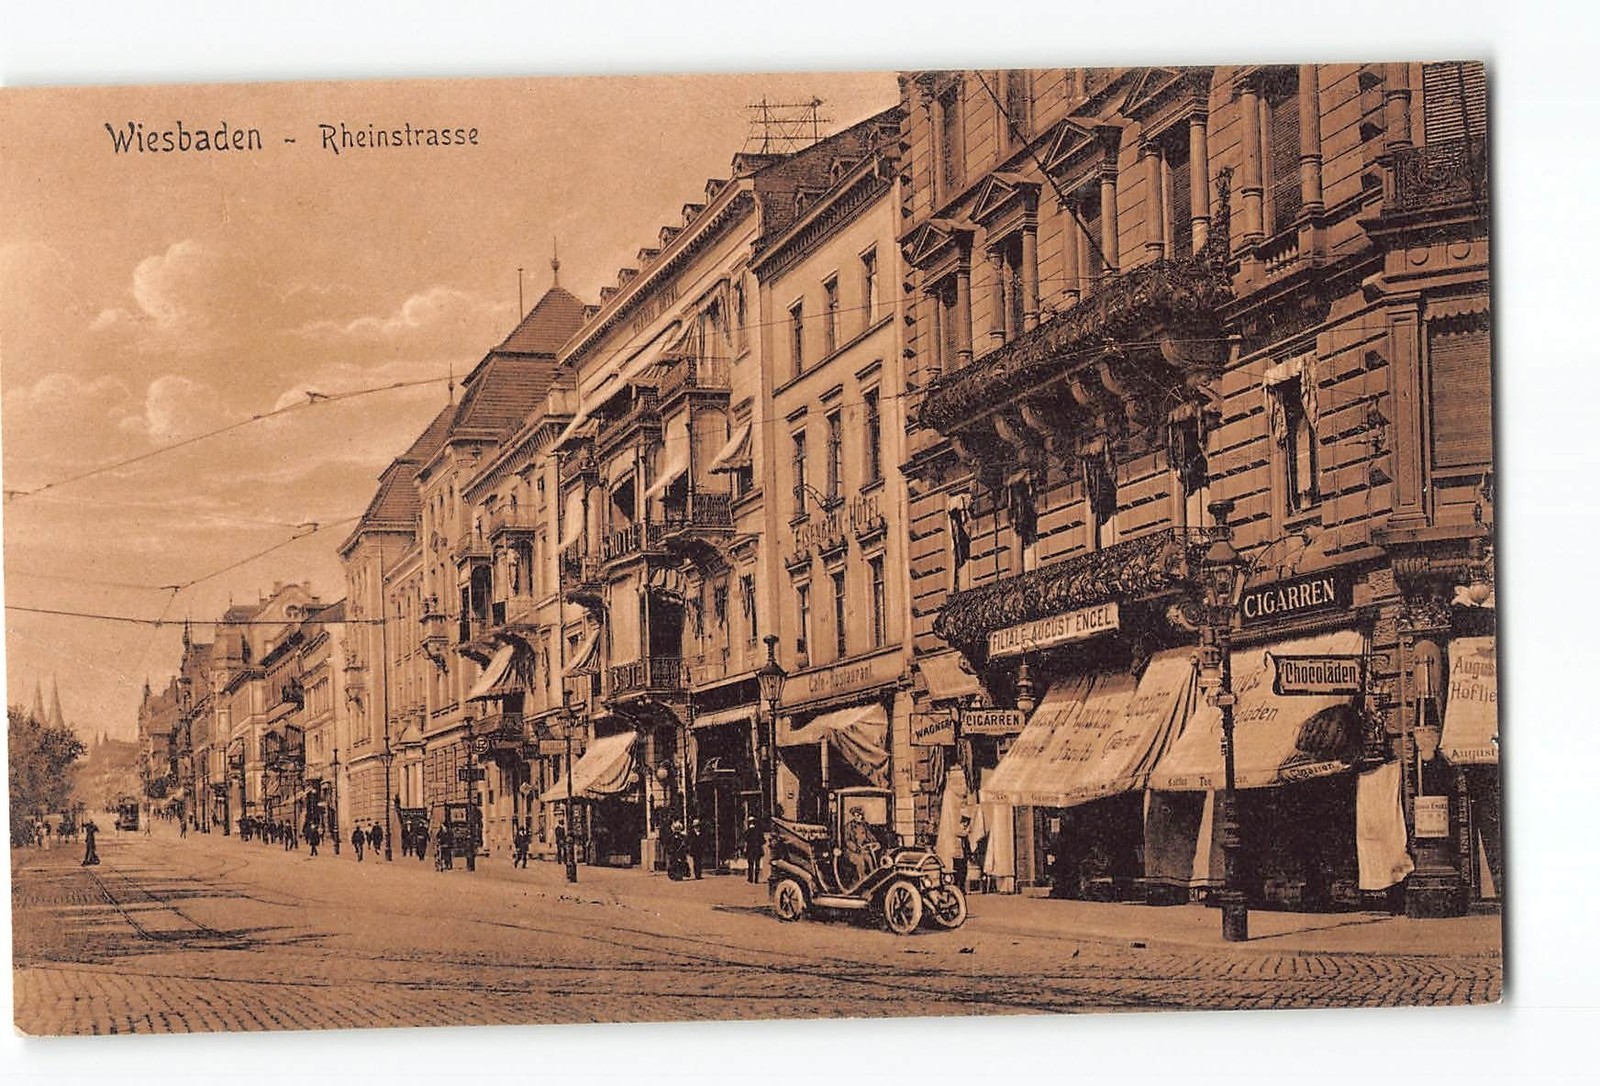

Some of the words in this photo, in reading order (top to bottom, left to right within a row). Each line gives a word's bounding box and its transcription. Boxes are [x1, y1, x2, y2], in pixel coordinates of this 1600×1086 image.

[1244, 577, 1334, 617] CIGARREN
[1031, 617, 1070, 640] AUGUST
[1285, 661, 1356, 684] Chocoladen
